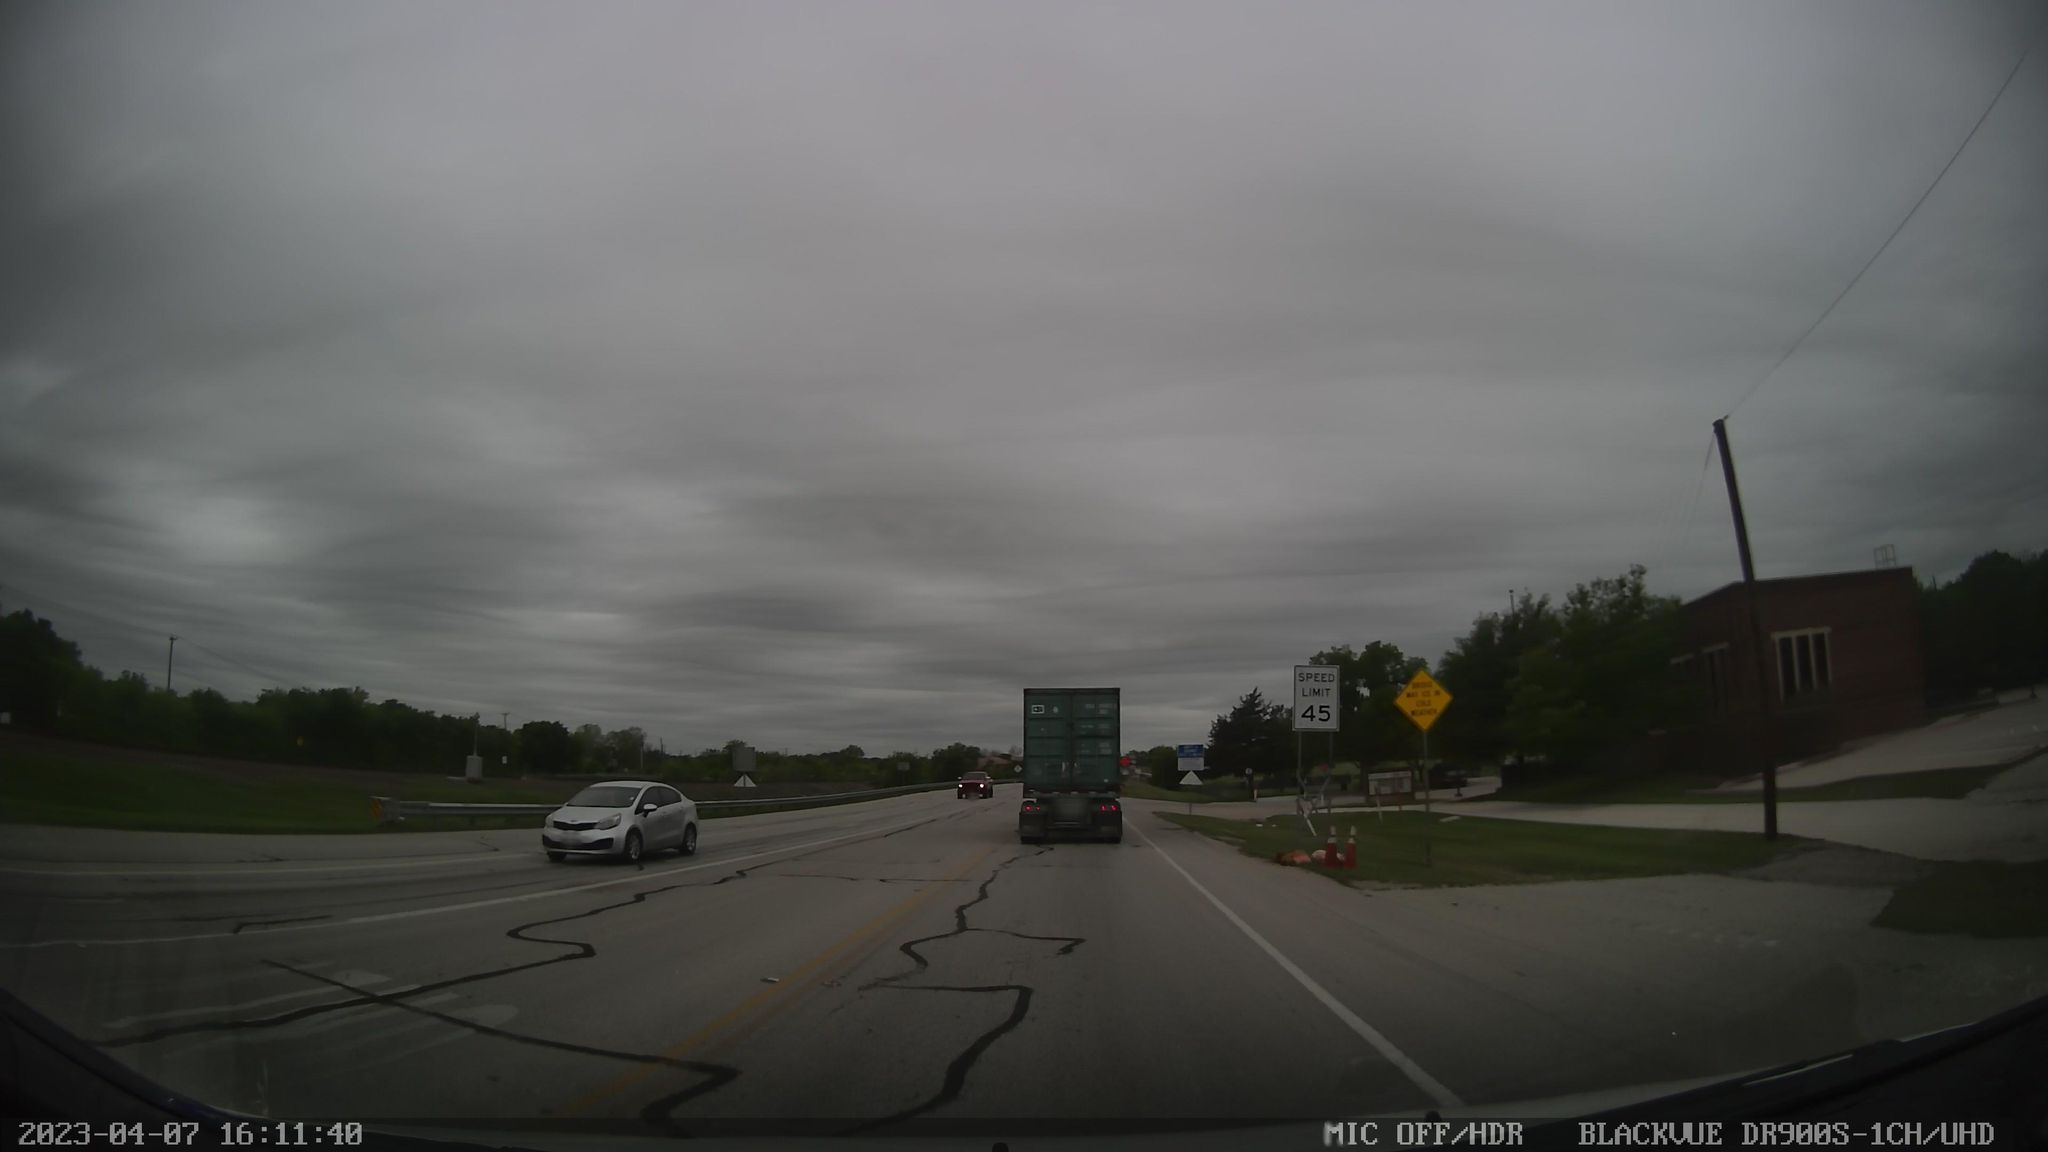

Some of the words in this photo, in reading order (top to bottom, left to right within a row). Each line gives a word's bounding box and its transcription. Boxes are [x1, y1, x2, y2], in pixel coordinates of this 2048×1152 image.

[1298, 672, 1335, 682] SPEED
[1301, 687, 1331, 697] LIMIT
[1301, 704, 1331, 722] 45
